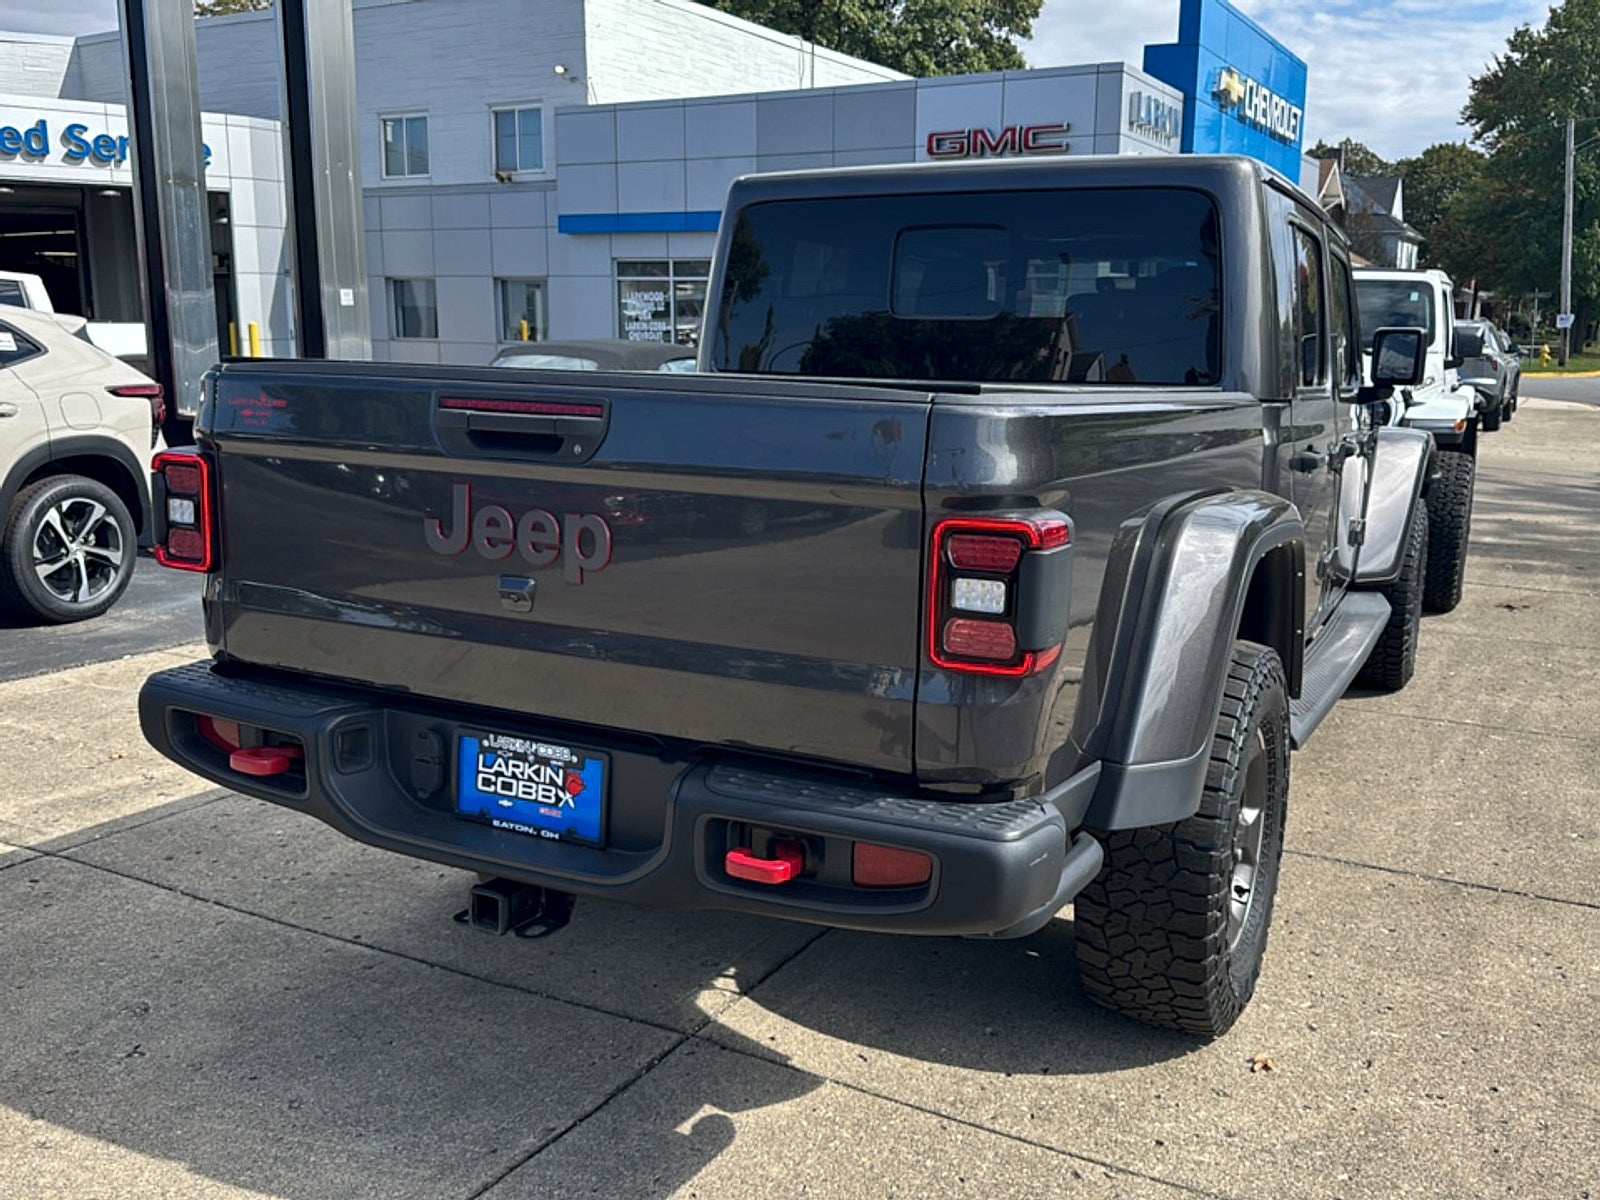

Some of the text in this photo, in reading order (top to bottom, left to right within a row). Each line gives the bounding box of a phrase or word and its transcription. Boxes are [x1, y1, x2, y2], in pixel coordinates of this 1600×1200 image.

[1244, 78, 1302, 142] CHEVROLET
[927, 122, 1069, 159] GMC
[424, 481, 612, 585] Jeep
[478, 753, 564, 787] LARKIN
[492, 819, 560, 840] EATON, OH
